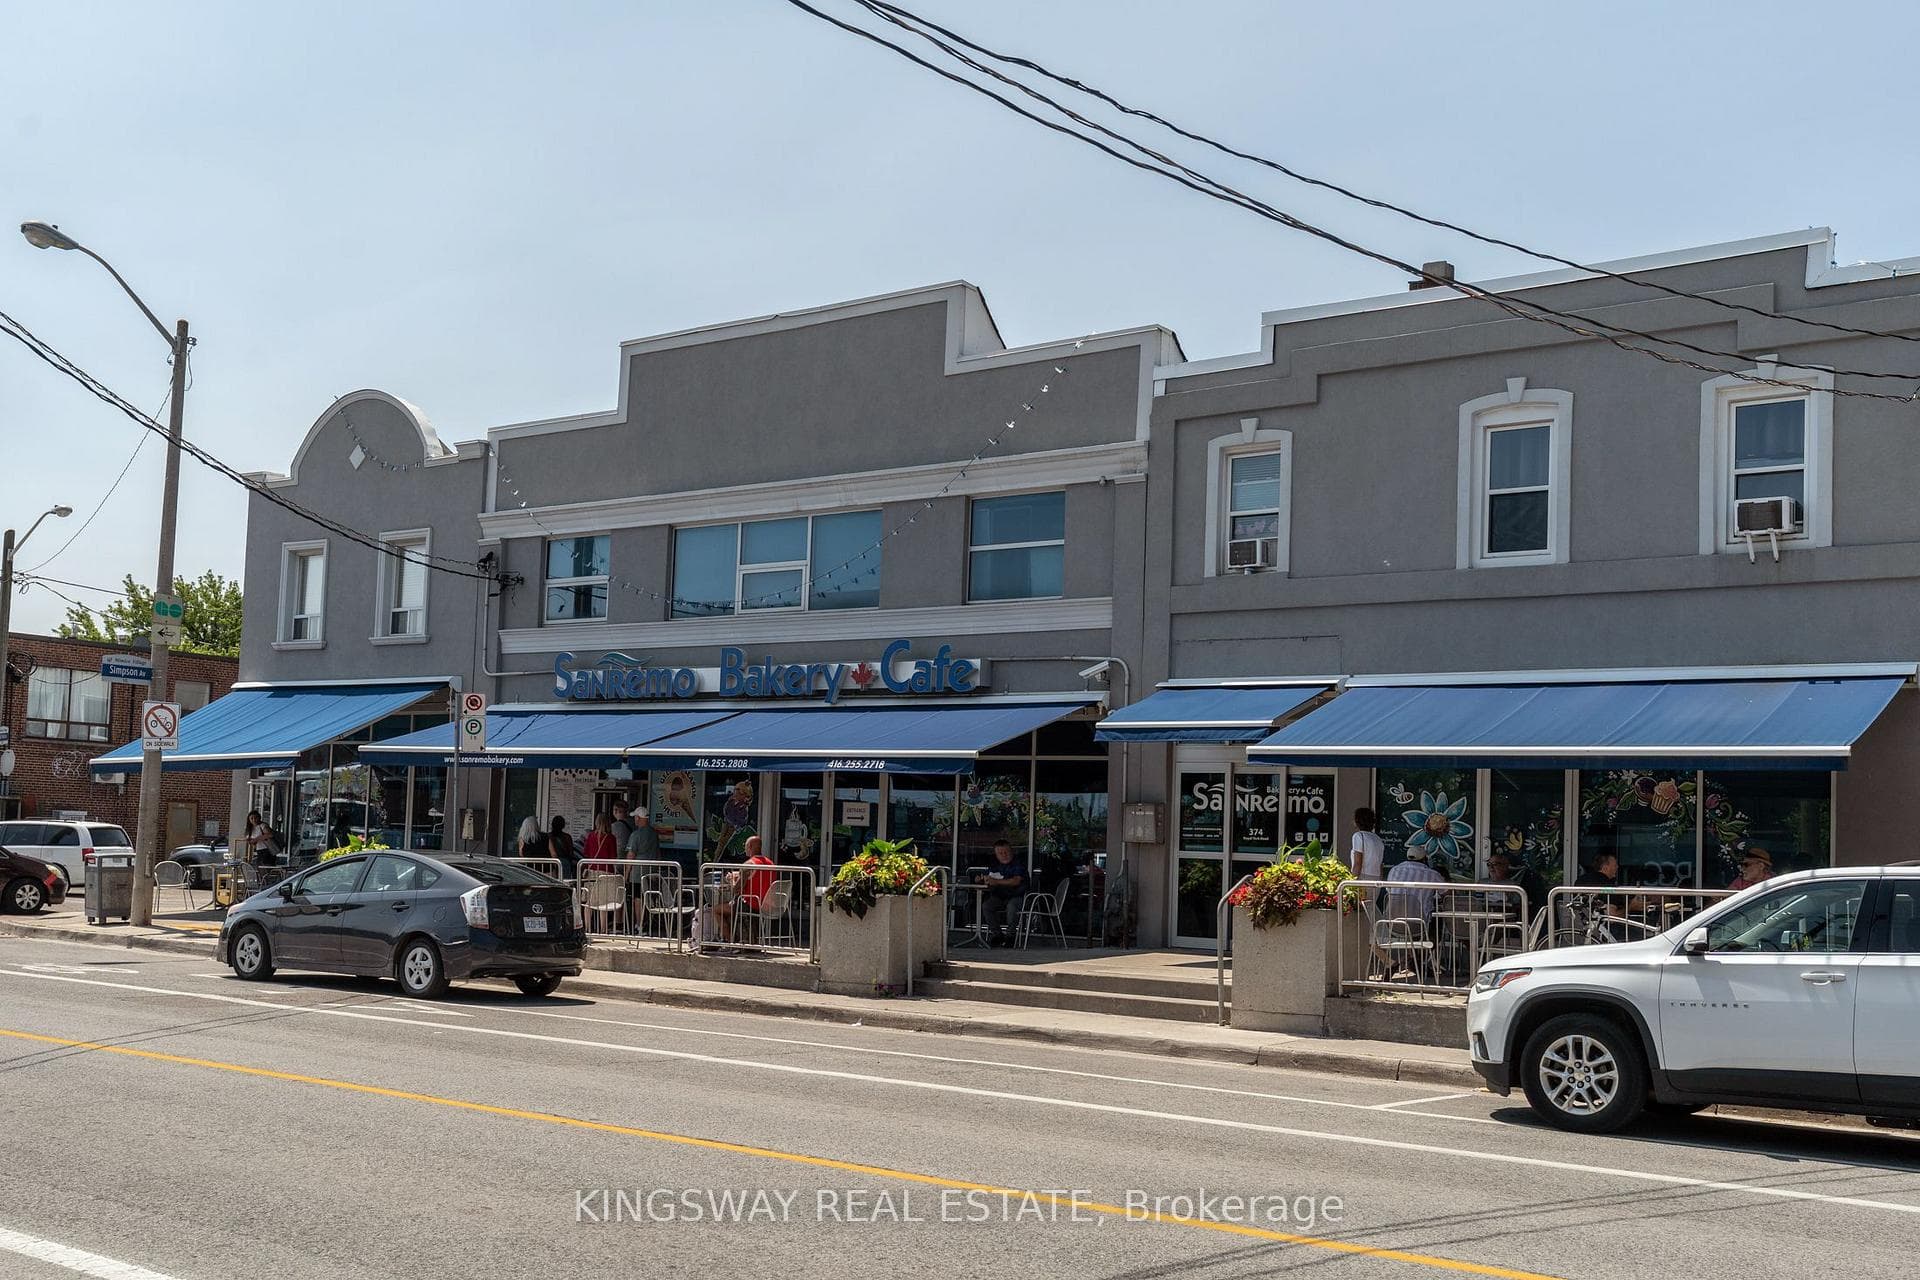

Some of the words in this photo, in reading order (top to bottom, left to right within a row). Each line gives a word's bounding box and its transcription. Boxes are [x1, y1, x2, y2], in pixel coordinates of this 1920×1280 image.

[109, 665, 138, 677] Simpson
[719, 646, 846, 704] Bakery
[880, 639, 979, 694] Cafe
[470, 722, 478, 732] P
[154, 740, 175, 748] SIDEWALK
[443, 755, 524, 766] ww.sanremobakery.com
[695, 758, 749, 768] 416.255.2808
[827, 759, 886, 769] 416.255.2718
[1305, 786, 1324, 796] Cafe
[1248, 828, 1264, 836] 374
